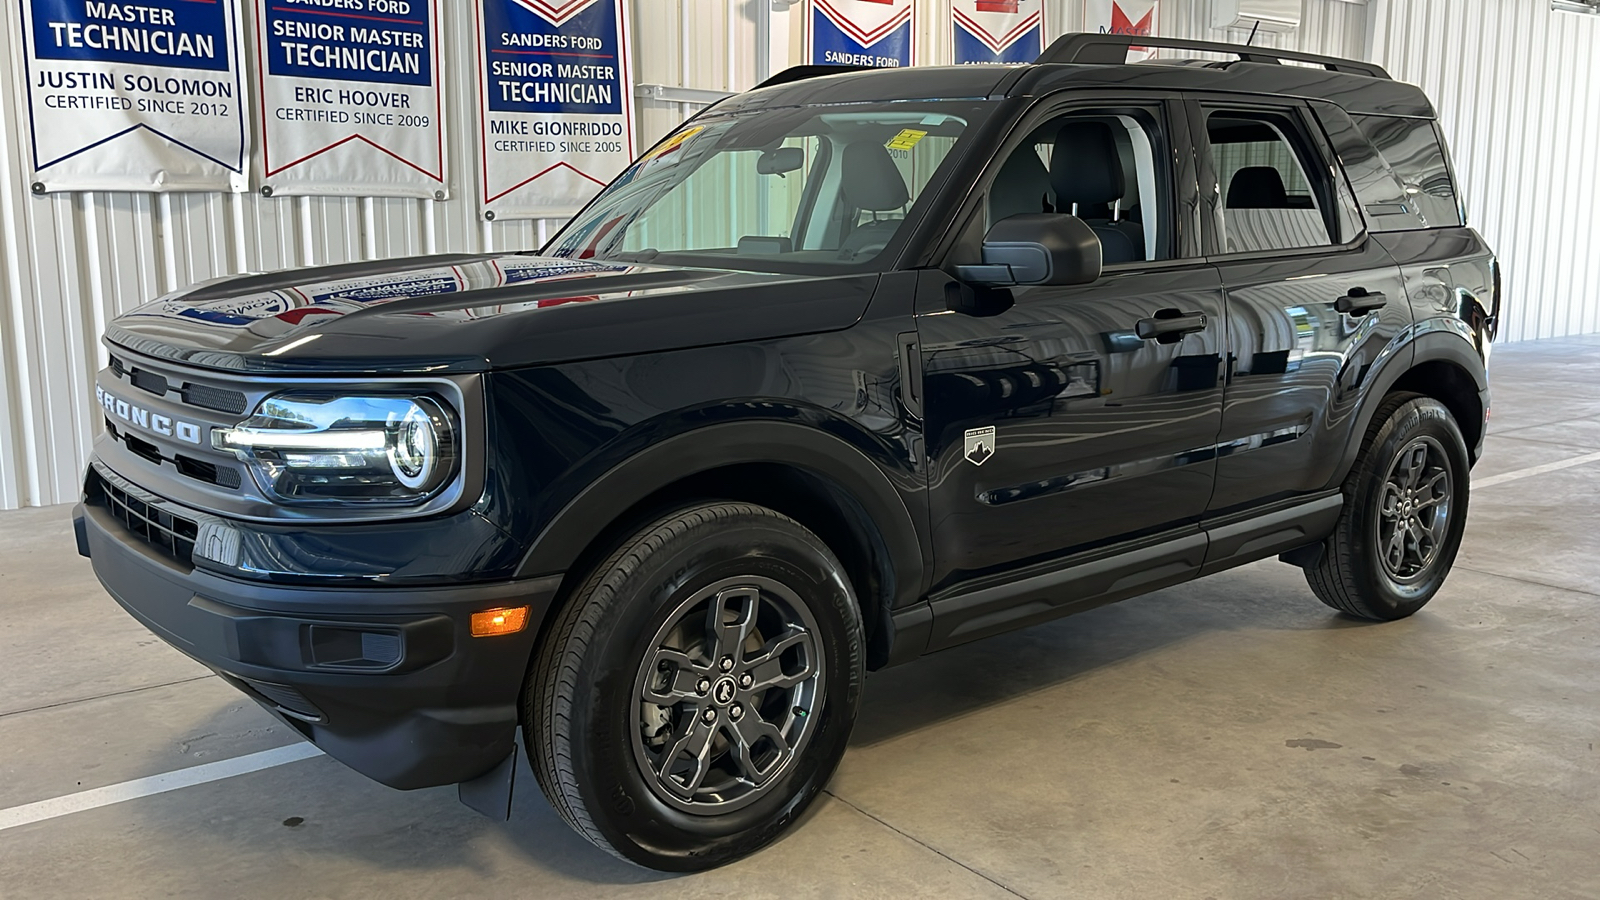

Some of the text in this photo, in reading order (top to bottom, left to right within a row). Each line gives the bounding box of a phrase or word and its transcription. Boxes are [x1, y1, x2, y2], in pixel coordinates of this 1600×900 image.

[85, 1, 176, 26] MASTER
[369, 0, 411, 15] FORD
[49, 22, 215, 58] TECHNICIAN
[273, 20, 424, 49] SENIOR MASTER
[501, 32, 603, 50] SANDERS FORD
[281, 42, 420, 75] TECHNICIAN
[824, 50, 900, 68] SANDERS FORD
[492, 61, 615, 80] SENIOR MASTER
[37, 71, 233, 98] JUSTIN SOLOMON
[498, 80, 612, 104] TECHNICIAN
[45, 95, 229, 117] CERTIFIED SINCE 2012
[295, 87, 411, 109] ERIC HOOVER
[275, 108, 430, 128] CERTIFIED SINCE 2009
[490, 120, 623, 136] MIKE GIONFRIDDO
[494, 140, 622, 153] CERTIFIED SINCE 2005
[96, 385, 201, 445] BRONCO
